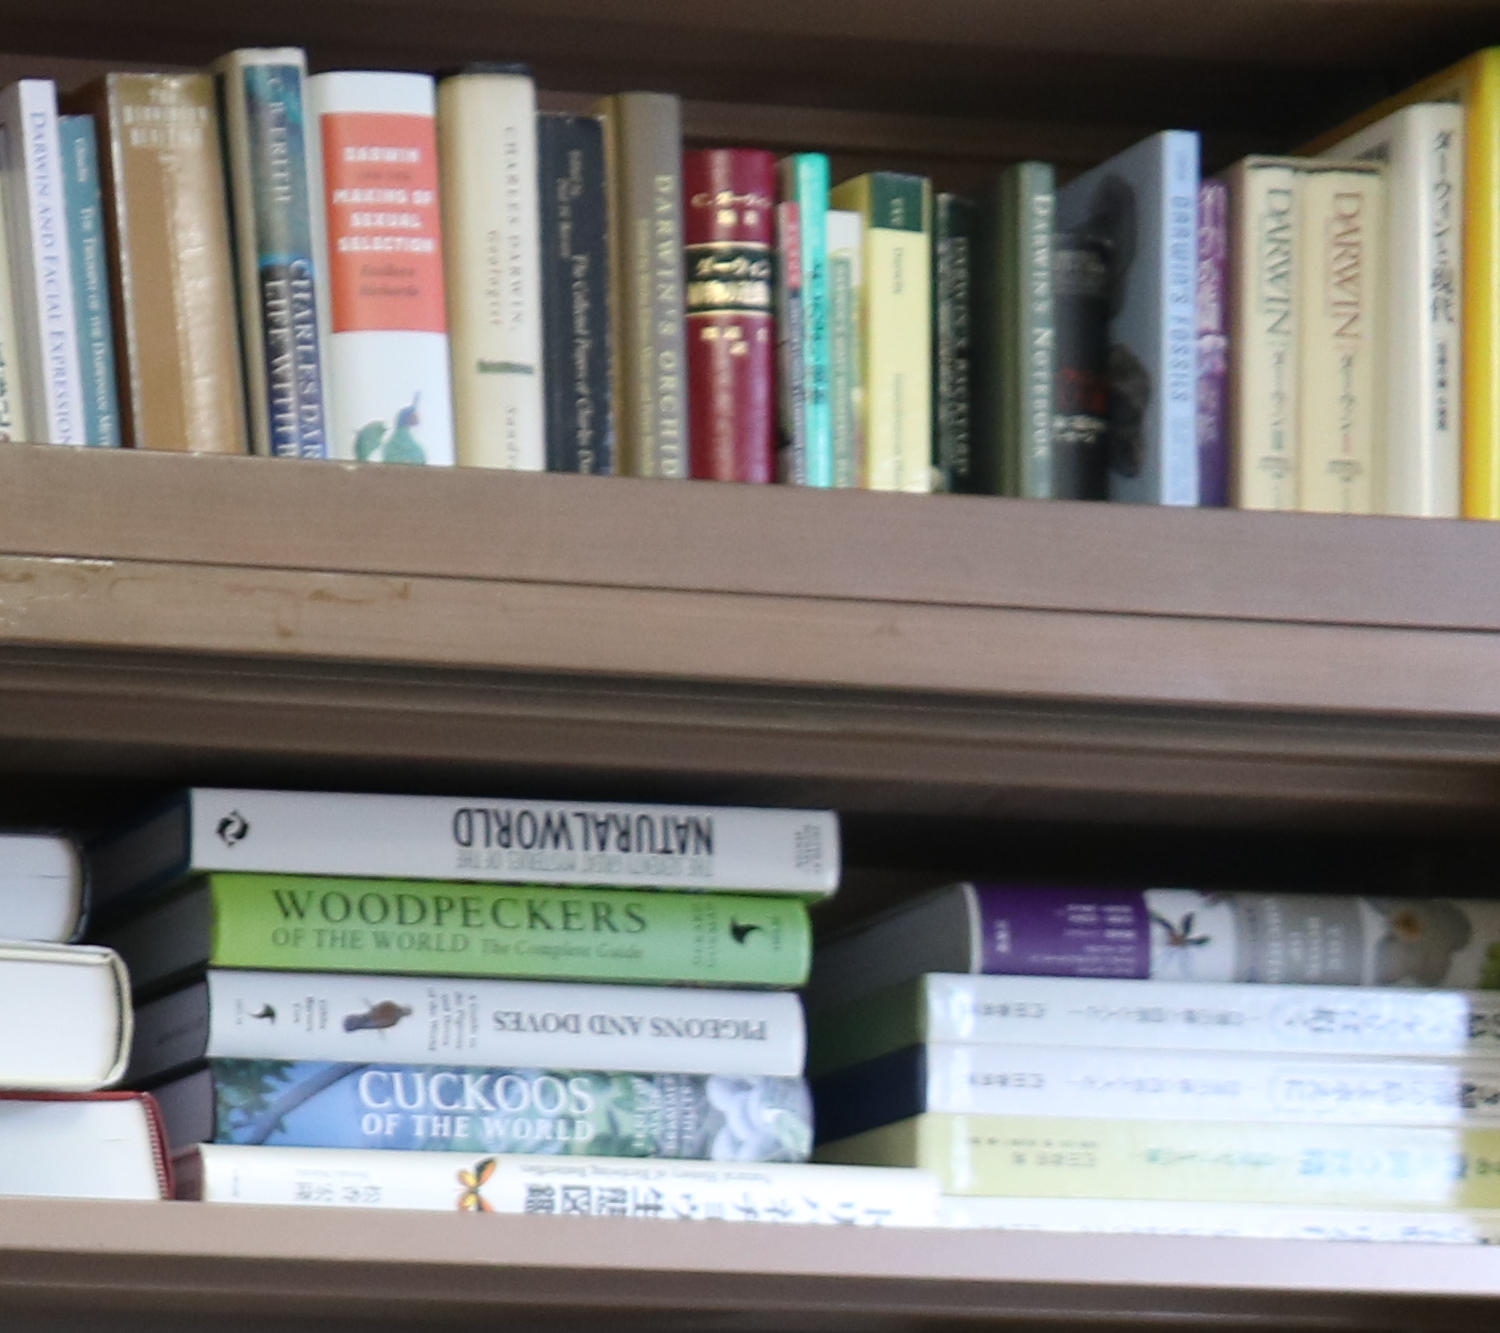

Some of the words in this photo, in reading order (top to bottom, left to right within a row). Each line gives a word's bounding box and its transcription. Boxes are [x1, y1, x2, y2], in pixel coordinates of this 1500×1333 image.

[28, 112, 51, 200] DARWIN
[343, 145, 421, 164] DARWIN
[502, 125, 520, 223] CHARLES
[333, 188, 408, 205] MAKING
[350, 211, 423, 229] SEXUAL
[36, 209, 58, 248] AND
[337, 235, 436, 254] SELECTION
[653, 173, 678, 338] DARWIN'S
[1263, 187, 1296, 355] DARWIN
[1329, 190, 1364, 354] DARWIN
[41, 253, 65, 327] FACIAL
[505, 234, 522, 334] DARWIN,
[50, 335, 76, 446] EXPRESSION
[1030, 325, 1055, 461] NOTEBOOK
[270, 886, 649, 936] WOODPECKERS
[270, 925, 308, 947] OF
[312, 927, 362, 950] THE
[368, 928, 471, 954] WORLD
[492, 1010, 574, 1034] DOVES
[647, 1015, 767, 1042] PIGEONS
[358, 1068, 597, 1115] CUCKOOS
[360, 1111, 405, 1139] OF
[410, 1112, 472, 1139] THE
[492, 1114, 597, 1143] WORLD
